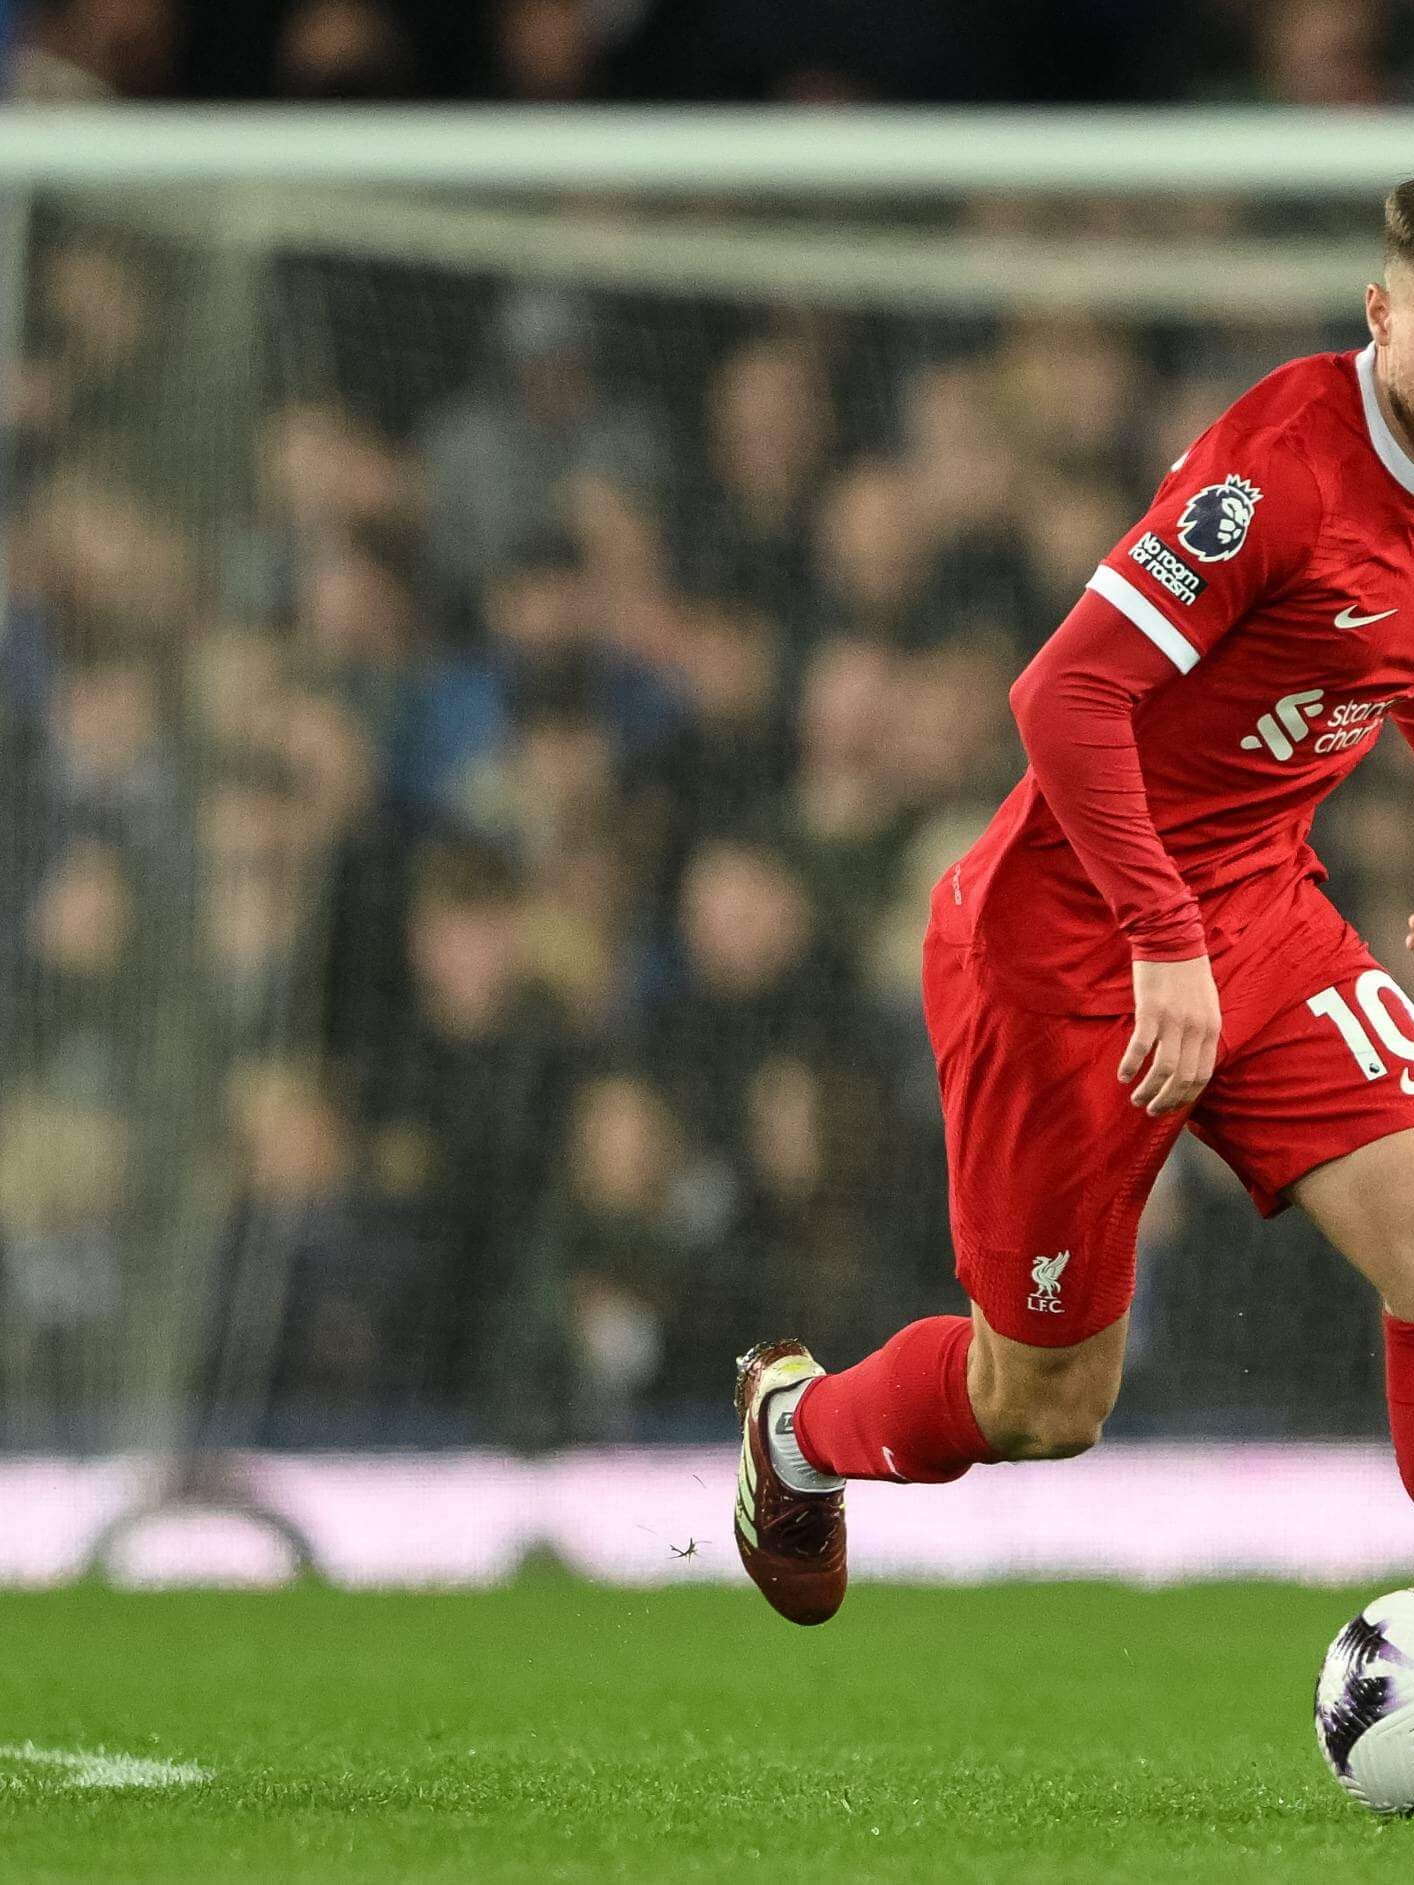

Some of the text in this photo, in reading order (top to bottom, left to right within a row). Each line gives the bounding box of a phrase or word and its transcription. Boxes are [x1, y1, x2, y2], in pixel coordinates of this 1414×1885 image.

[1127, 543, 1196, 606] for racism
[1138, 531, 1200, 590] No room
[1327, 699, 1394, 727] stan
